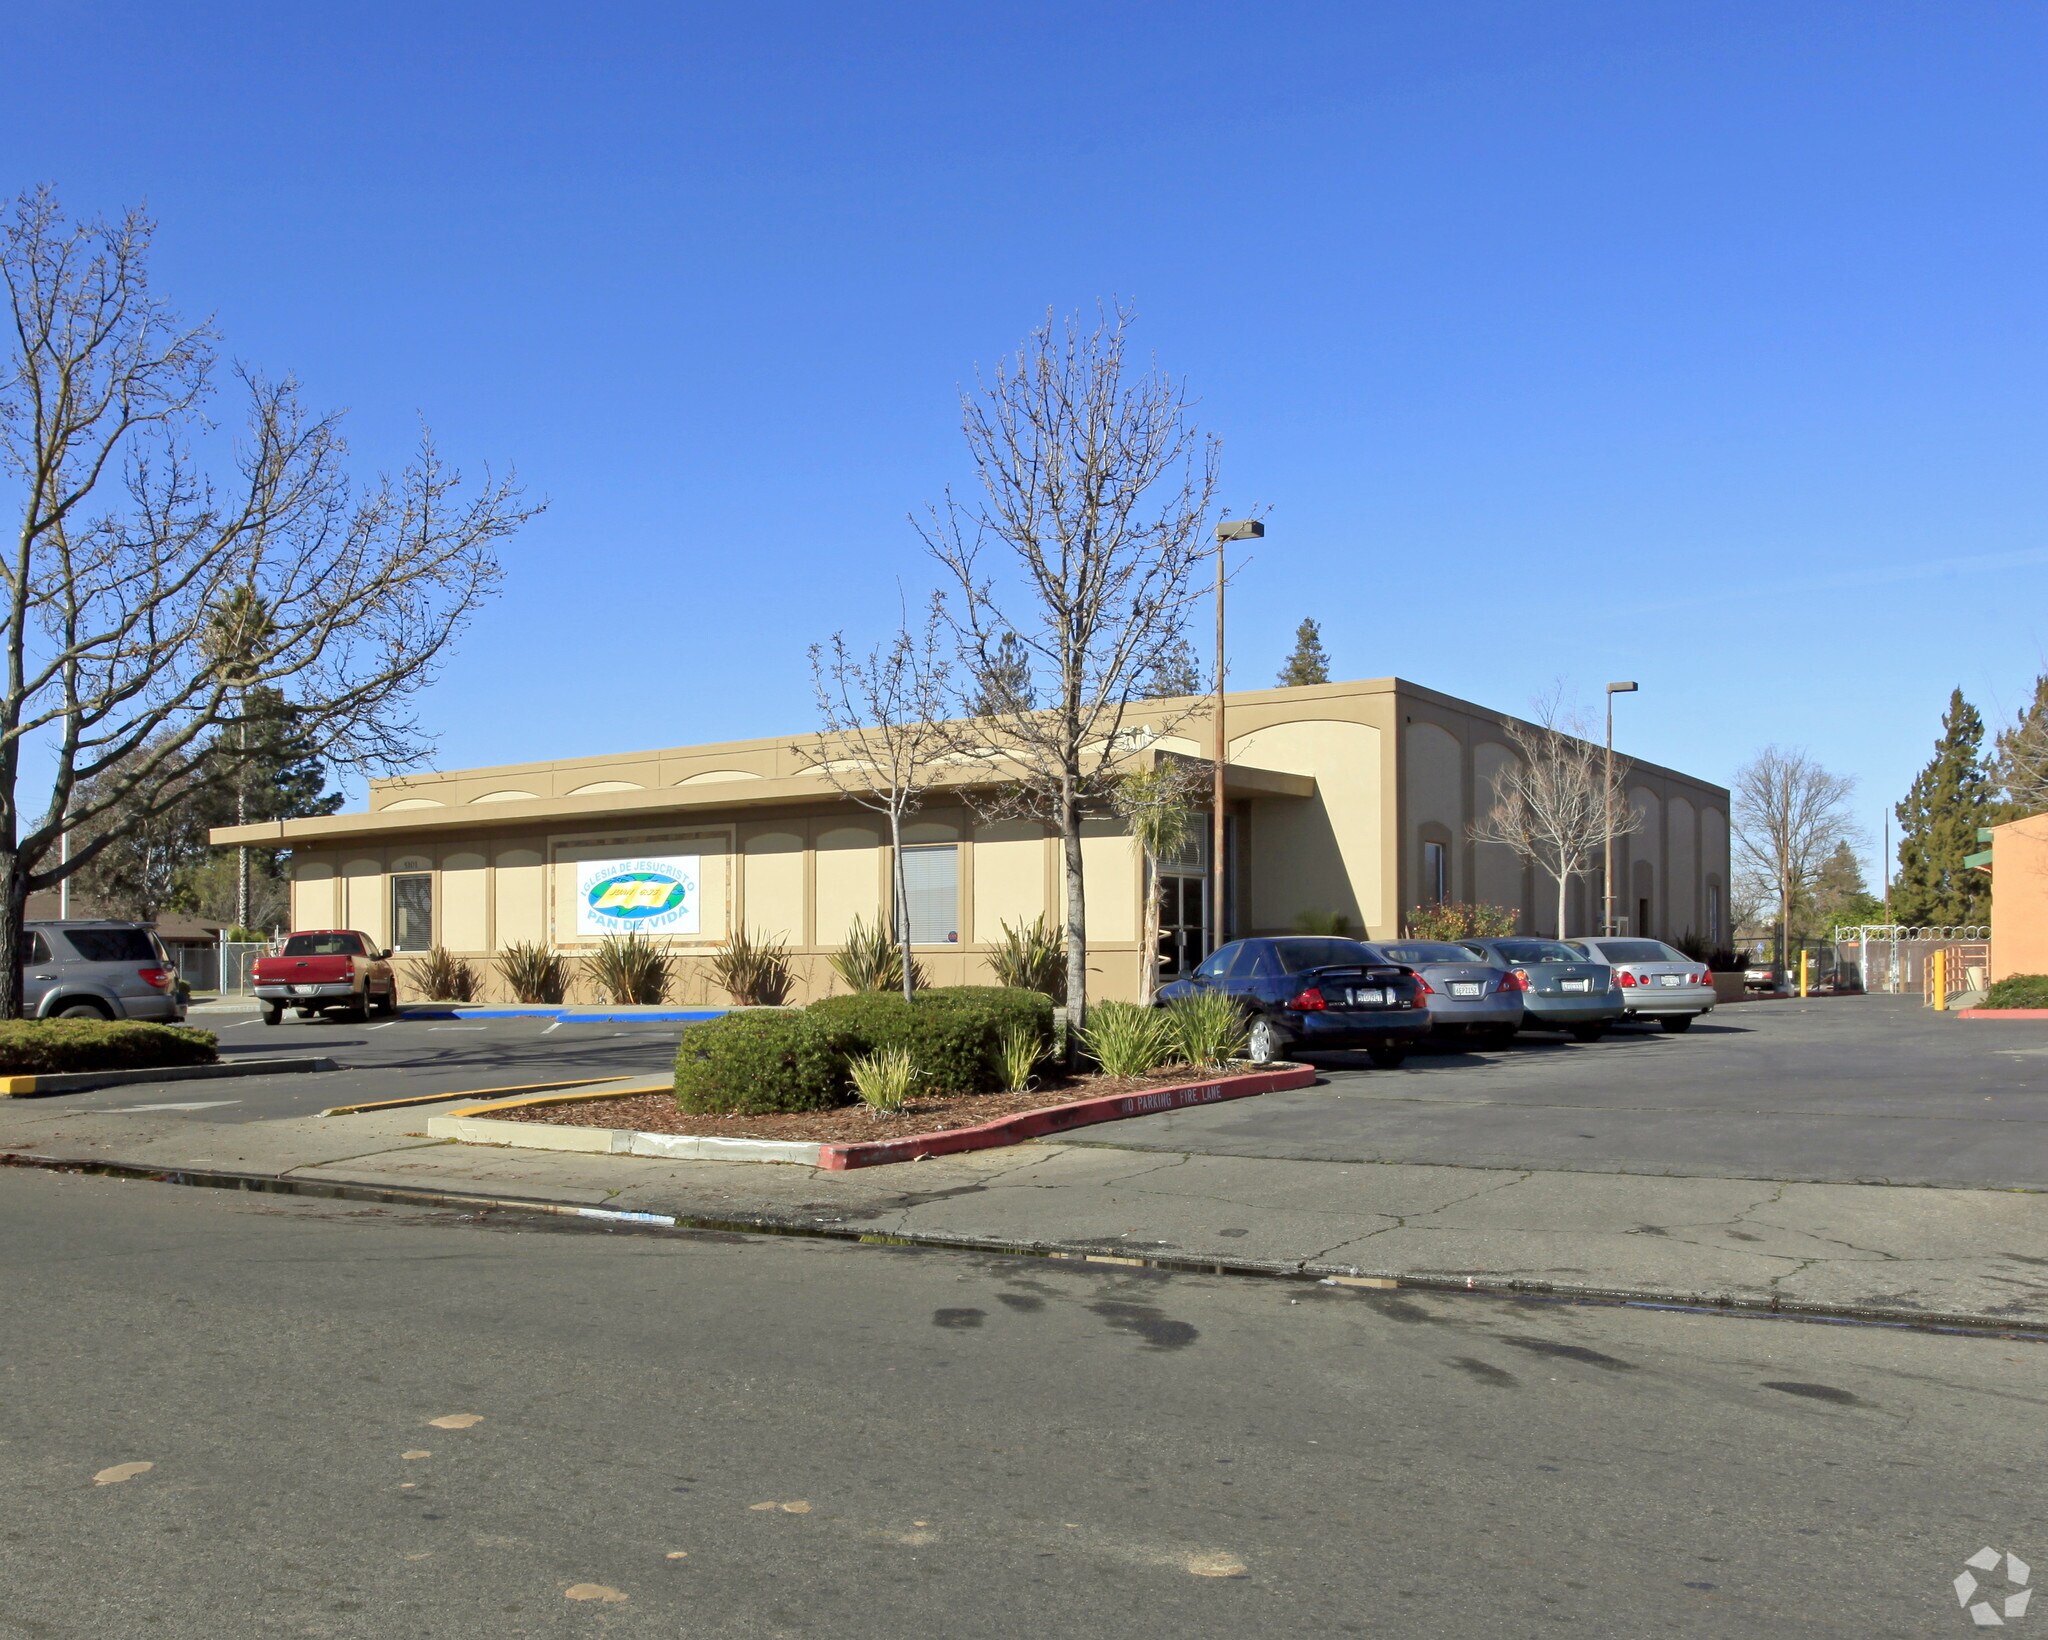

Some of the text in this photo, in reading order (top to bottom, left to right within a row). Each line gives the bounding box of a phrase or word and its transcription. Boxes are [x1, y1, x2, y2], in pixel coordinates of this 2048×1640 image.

[580, 861, 695, 897] IGLESIA DE JESUCRISTO
[587, 905, 689, 931] PAN DE VIDA
[1137, 1092, 1172, 1111] PARKING
[1179, 1088, 1198, 1104] FIRE
[1201, 1085, 1222, 1100] LANE
